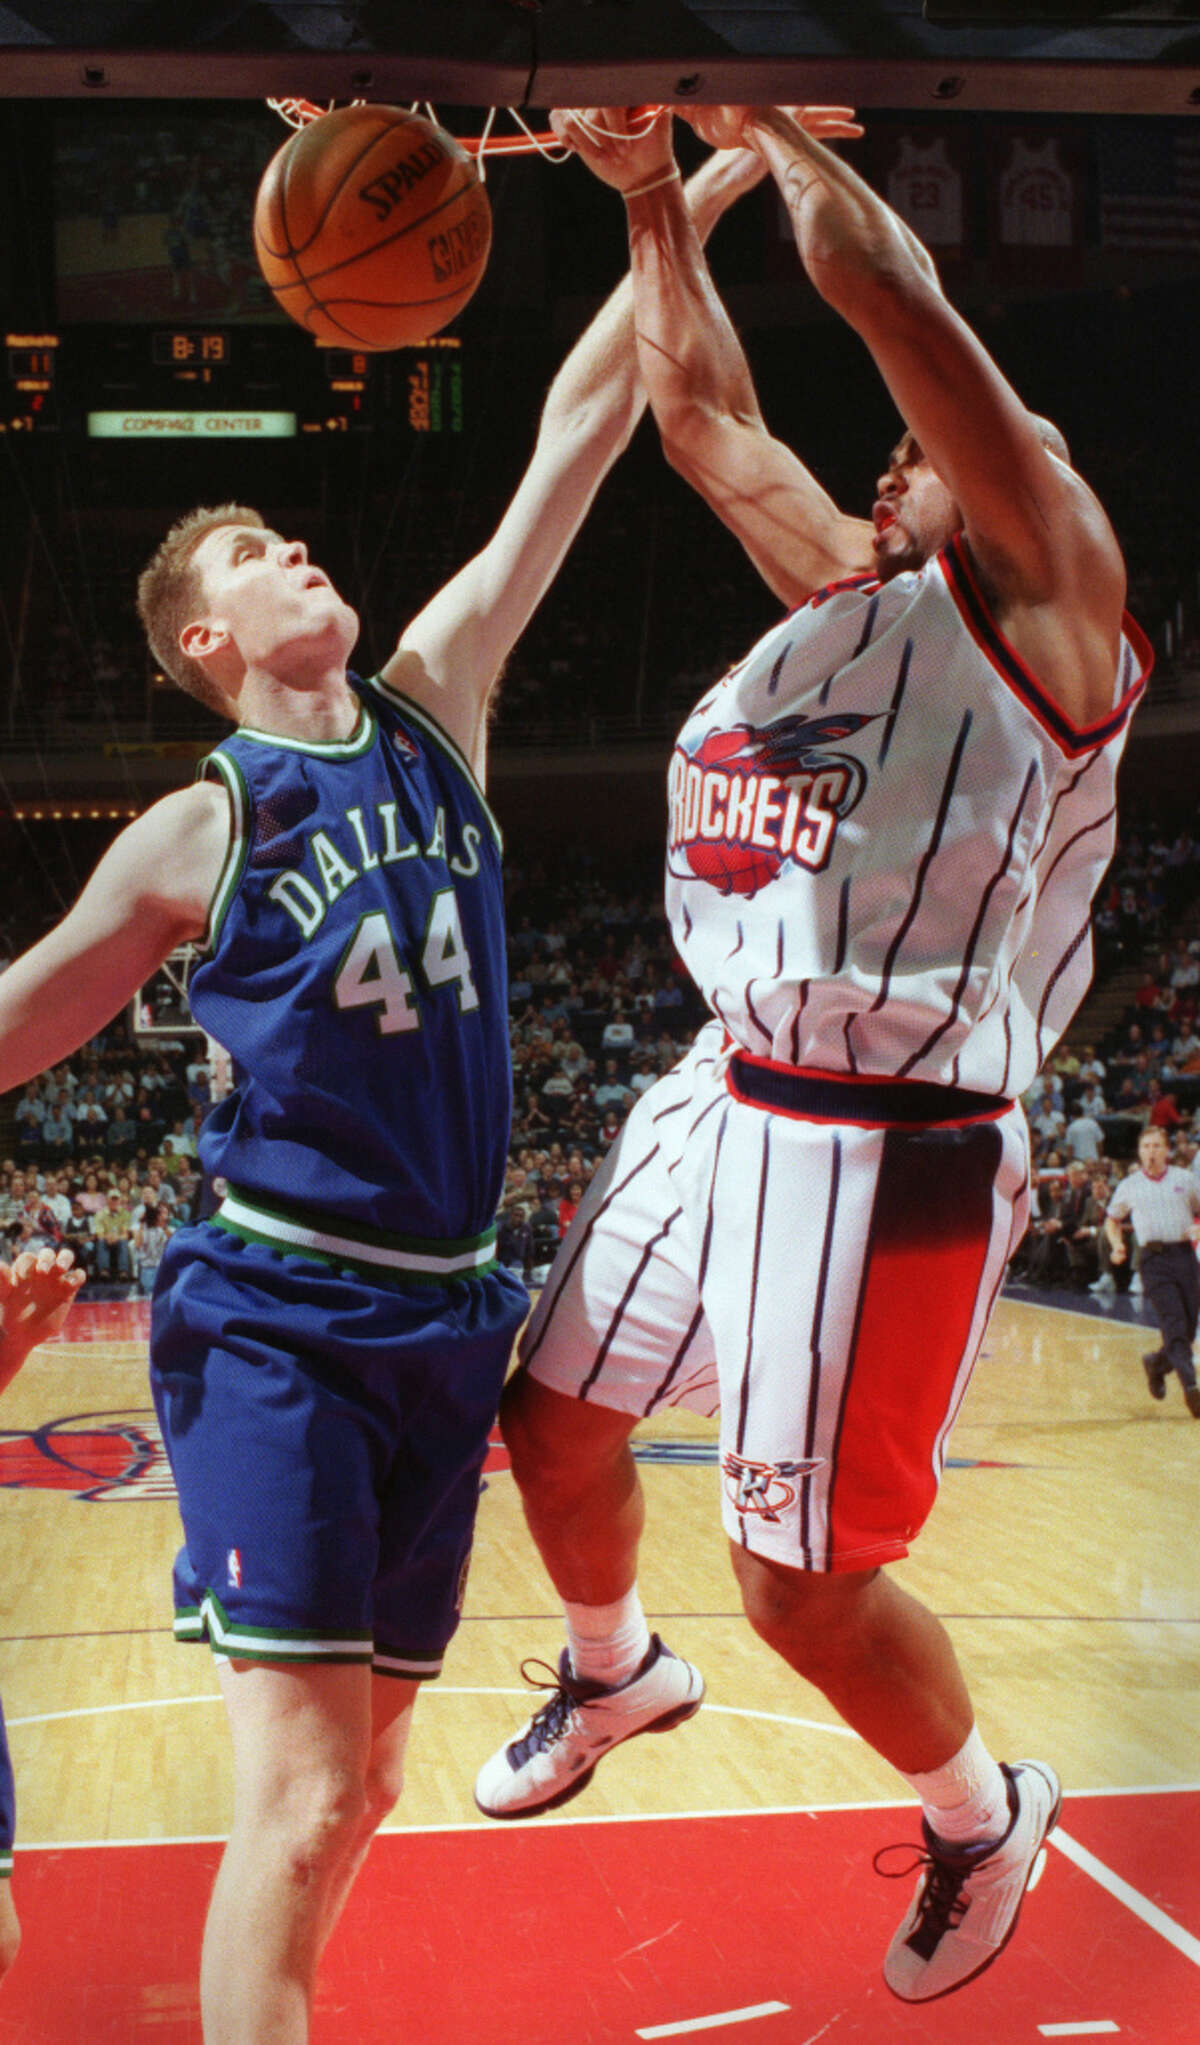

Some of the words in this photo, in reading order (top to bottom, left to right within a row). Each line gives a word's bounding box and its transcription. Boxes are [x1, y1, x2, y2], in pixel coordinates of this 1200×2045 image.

[122, 416, 195, 433] COMPAQ
[204, 416, 262, 432] CENTER
[266, 801, 482, 942] DALLAS
[668, 746, 852, 872] ROCKETS
[333, 886, 480, 1035] 44
